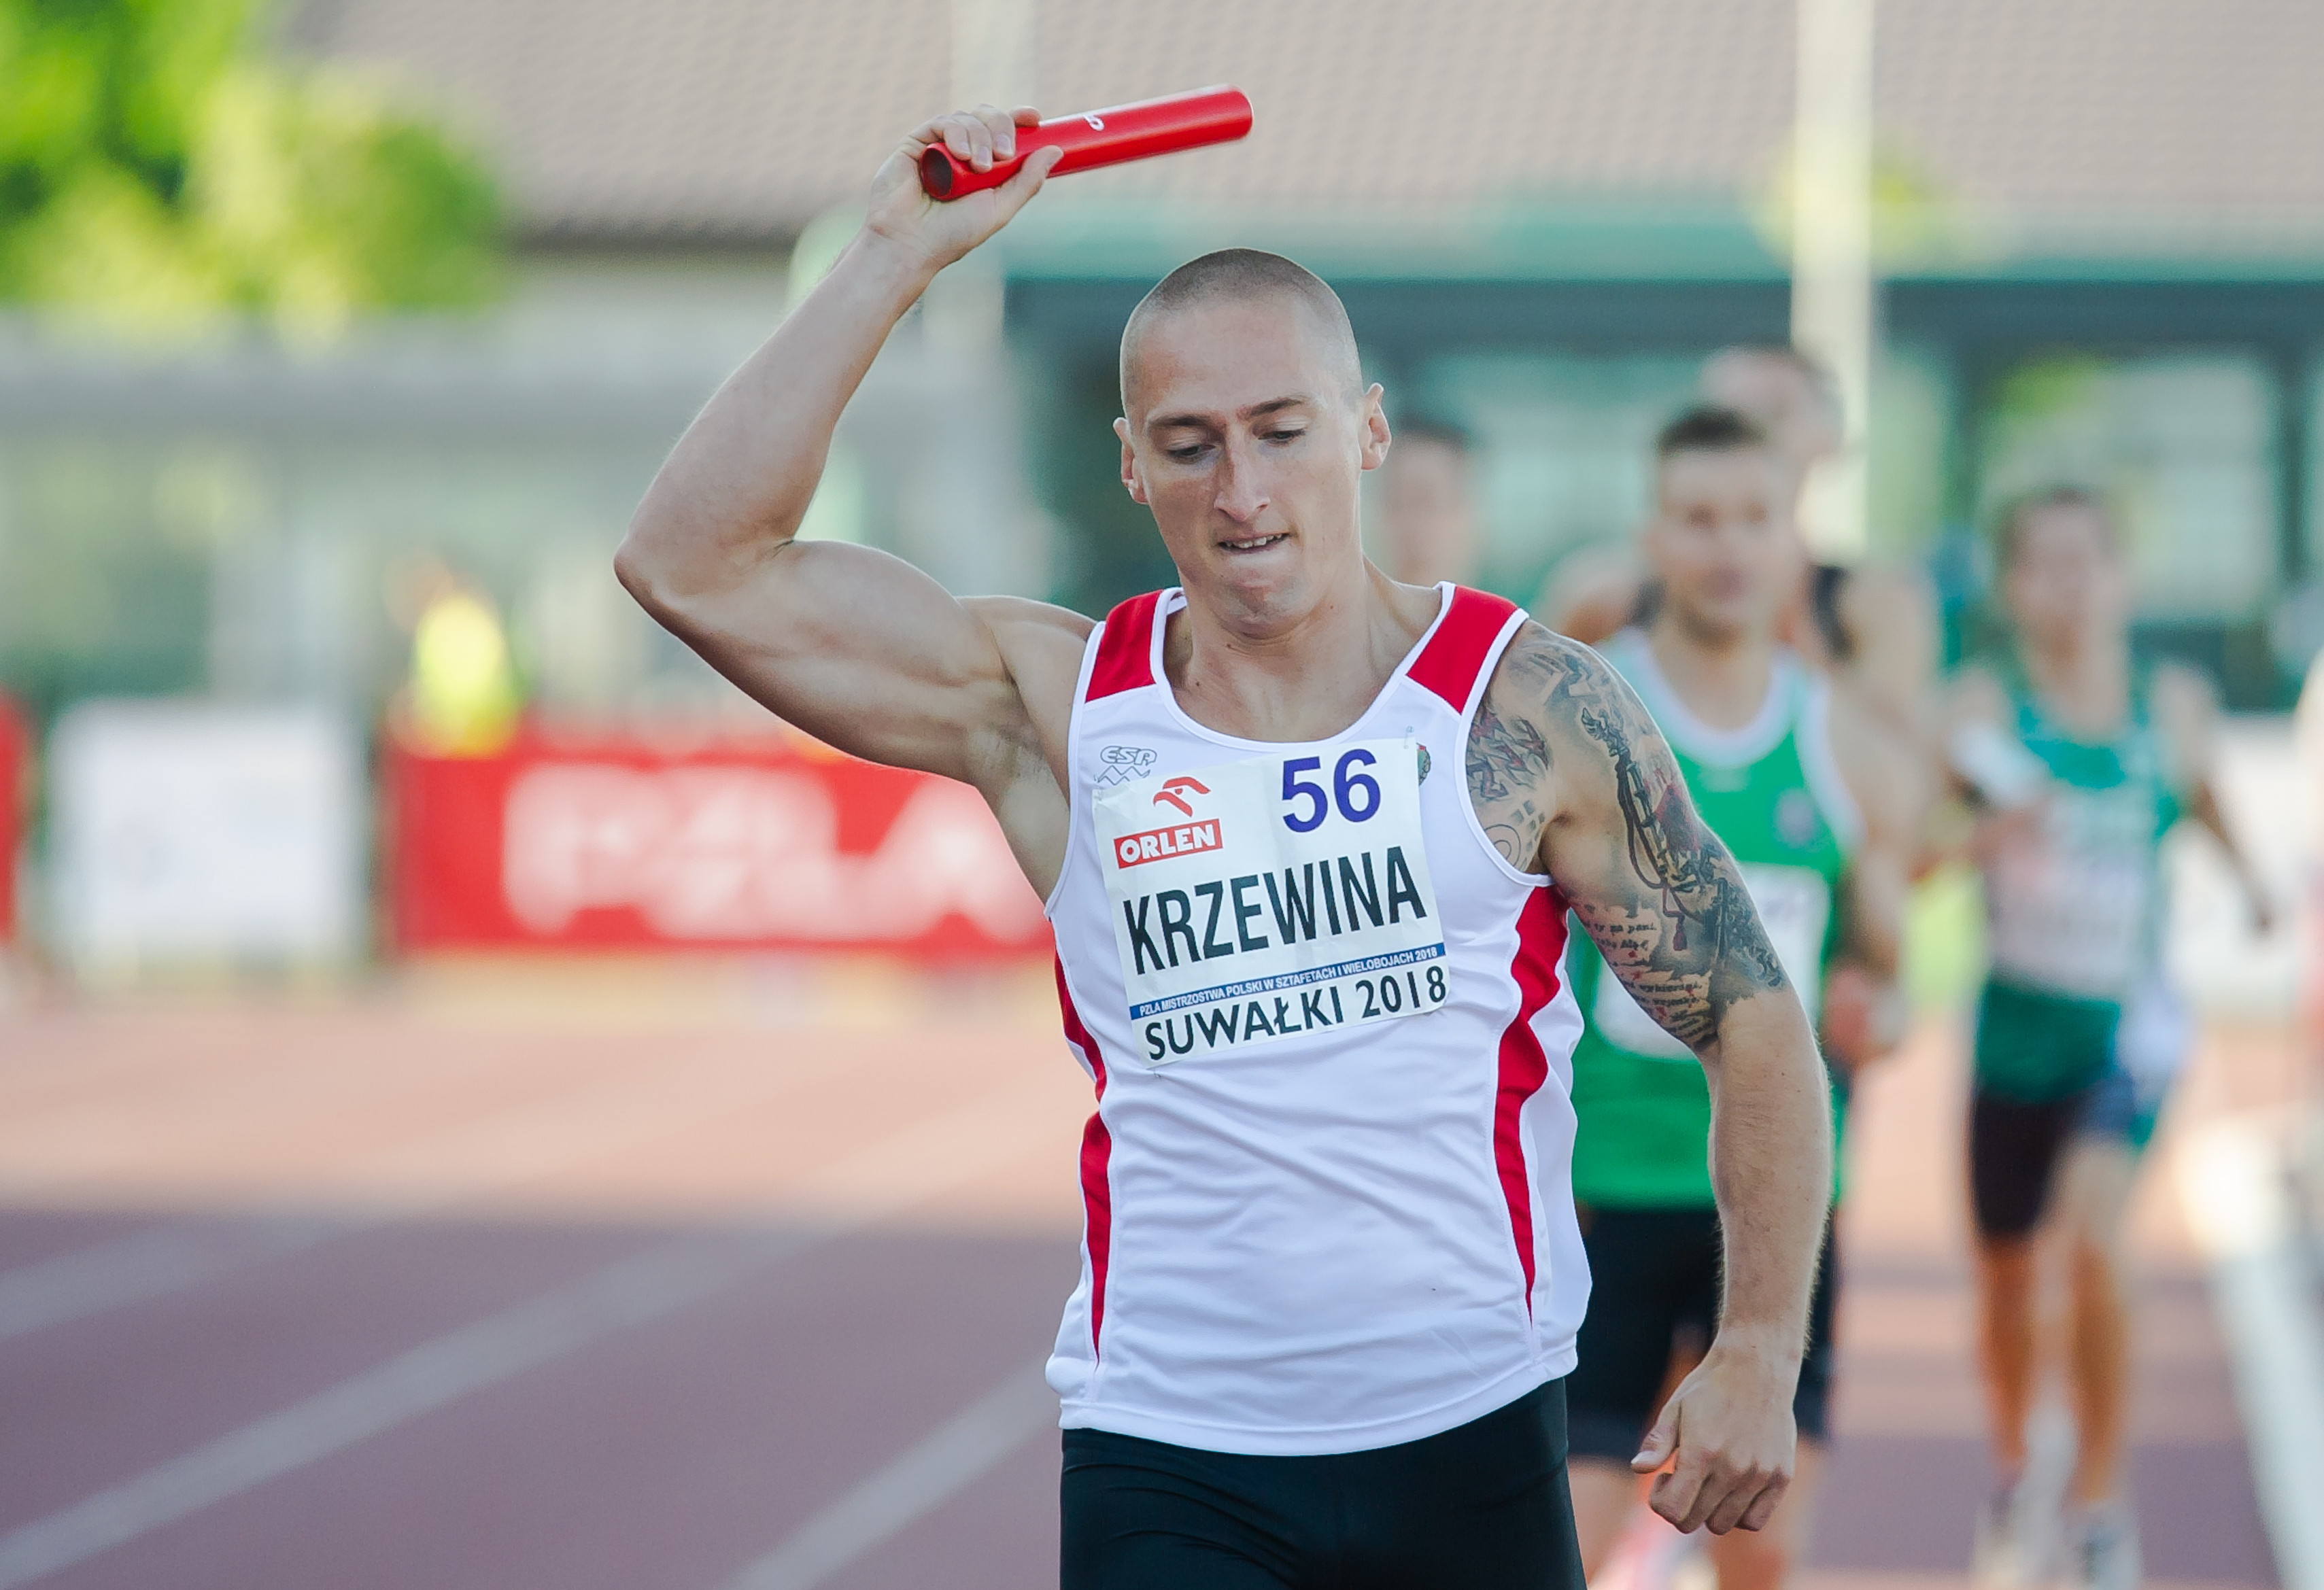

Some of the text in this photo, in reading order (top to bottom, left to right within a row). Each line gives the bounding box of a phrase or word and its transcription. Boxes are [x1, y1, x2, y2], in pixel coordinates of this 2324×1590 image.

[1282, 748, 1381, 833] 56
[1119, 823, 1216, 864] ORLEN
[1123, 846, 1426, 975] KRZEWINA
[1140, 1003, 1161, 1017] PZLA
[1161, 989, 1225, 1012] MISTRZOSTWA
[1226, 981, 1263, 998] POLSKI
[1263, 978, 1274, 990] W
[1276, 967, 1337, 988] SZTAFETACH
[1342, 952, 1414, 975] WIELOBOJACH
[1416, 946, 1437, 961] 2018
[1145, 965, 1446, 1060] SUWAŁKI 2018
